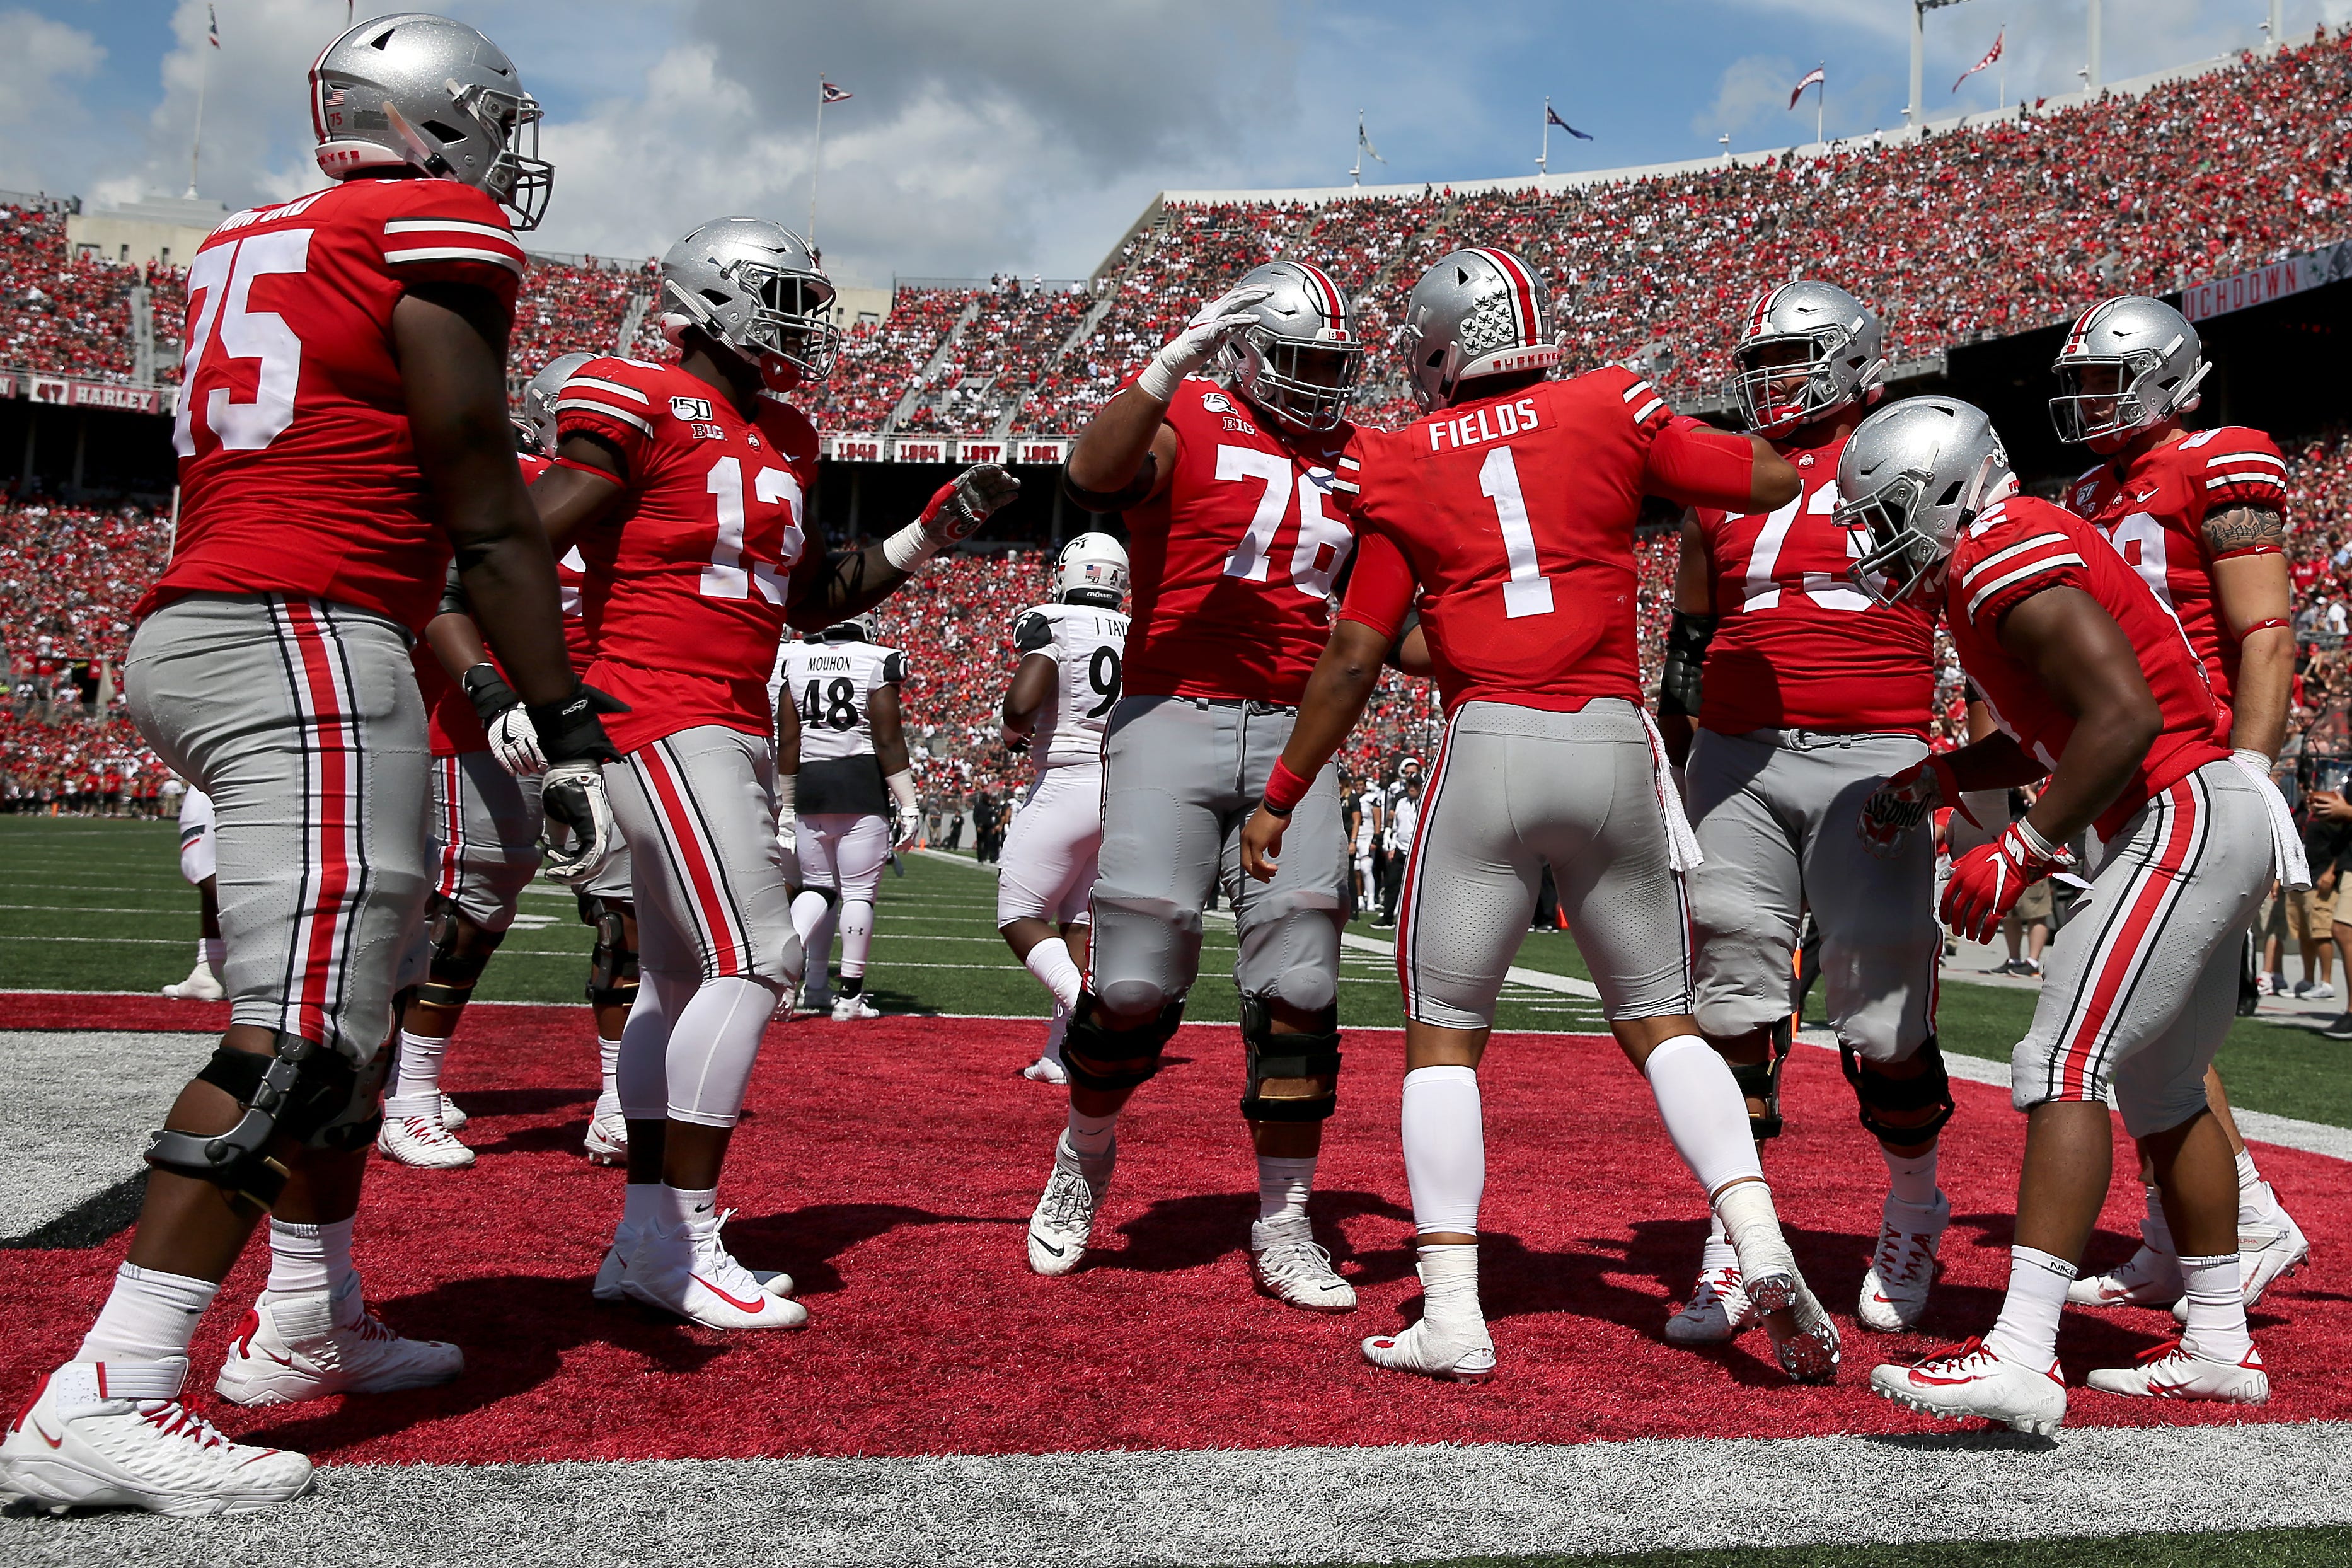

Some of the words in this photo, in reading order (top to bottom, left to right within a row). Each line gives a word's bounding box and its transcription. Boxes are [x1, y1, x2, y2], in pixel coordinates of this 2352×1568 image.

[330, 112, 343, 127] 75
[172, 228, 315, 458] 75
[76, 386, 153, 410] HARLEY
[1428, 398, 1540, 451] FIELDS
[699, 456, 806, 605] 13
[1214, 444, 1354, 599] 76
[1478, 445, 1555, 619] 1
[807, 656, 851, 671] MOUHON
[802, 677, 859, 732] 48
[2049, 1262, 2075, 1276] NIKE
